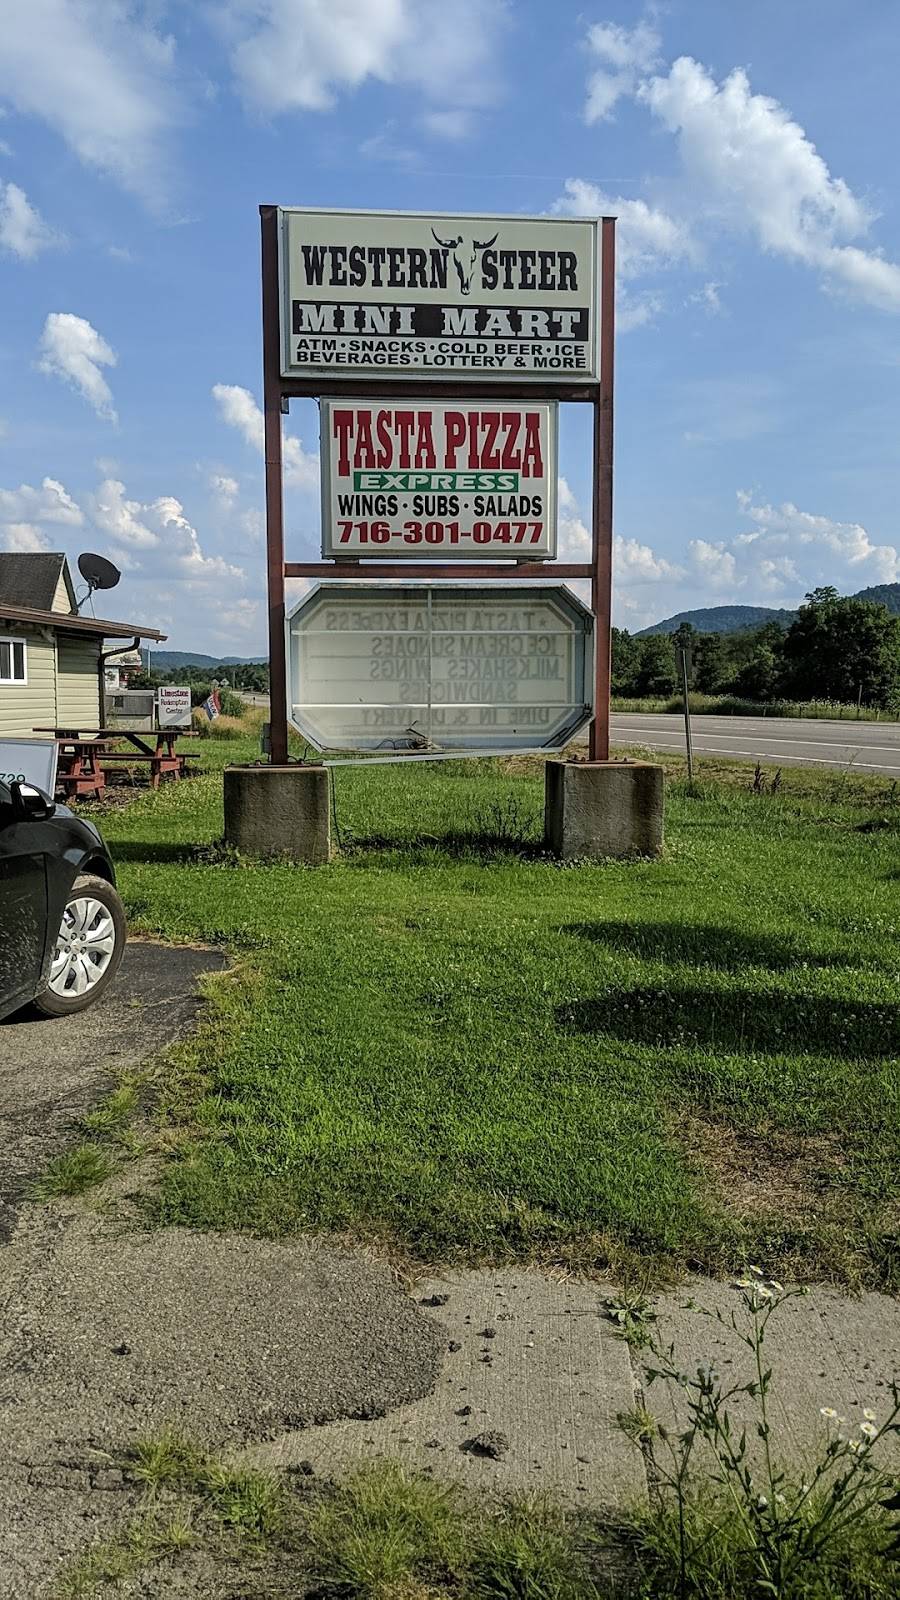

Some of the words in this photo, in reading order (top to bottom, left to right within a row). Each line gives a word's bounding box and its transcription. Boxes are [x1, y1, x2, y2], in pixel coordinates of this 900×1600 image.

[301, 245, 449, 289] WESTERN
[481, 250, 578, 291] STEER
[299, 304, 416, 335] MINI
[441, 307, 581, 339] MART
[297, 339, 337, 351] ATM
[349, 340, 426, 353] SNACKS
[438, 342, 488, 355] COLD
[494, 343, 543, 356] BEER
[554, 344, 585, 357] ICE
[297, 351, 411, 365] BEVERAGES
[423, 355, 507, 368] LOTTERY
[513, 356, 527, 368] &
[533, 357, 587, 369] MORE
[333, 409, 437, 477] TASTA
[444, 411, 544, 478] PIZZA
[359, 474, 515, 491] EXPRESS
[337, 494, 398, 517] WINGS
[412, 495, 460, 517] SUBS
[473, 495, 543, 517] SALADS
[337, 521, 543, 544] 716-301-0477
